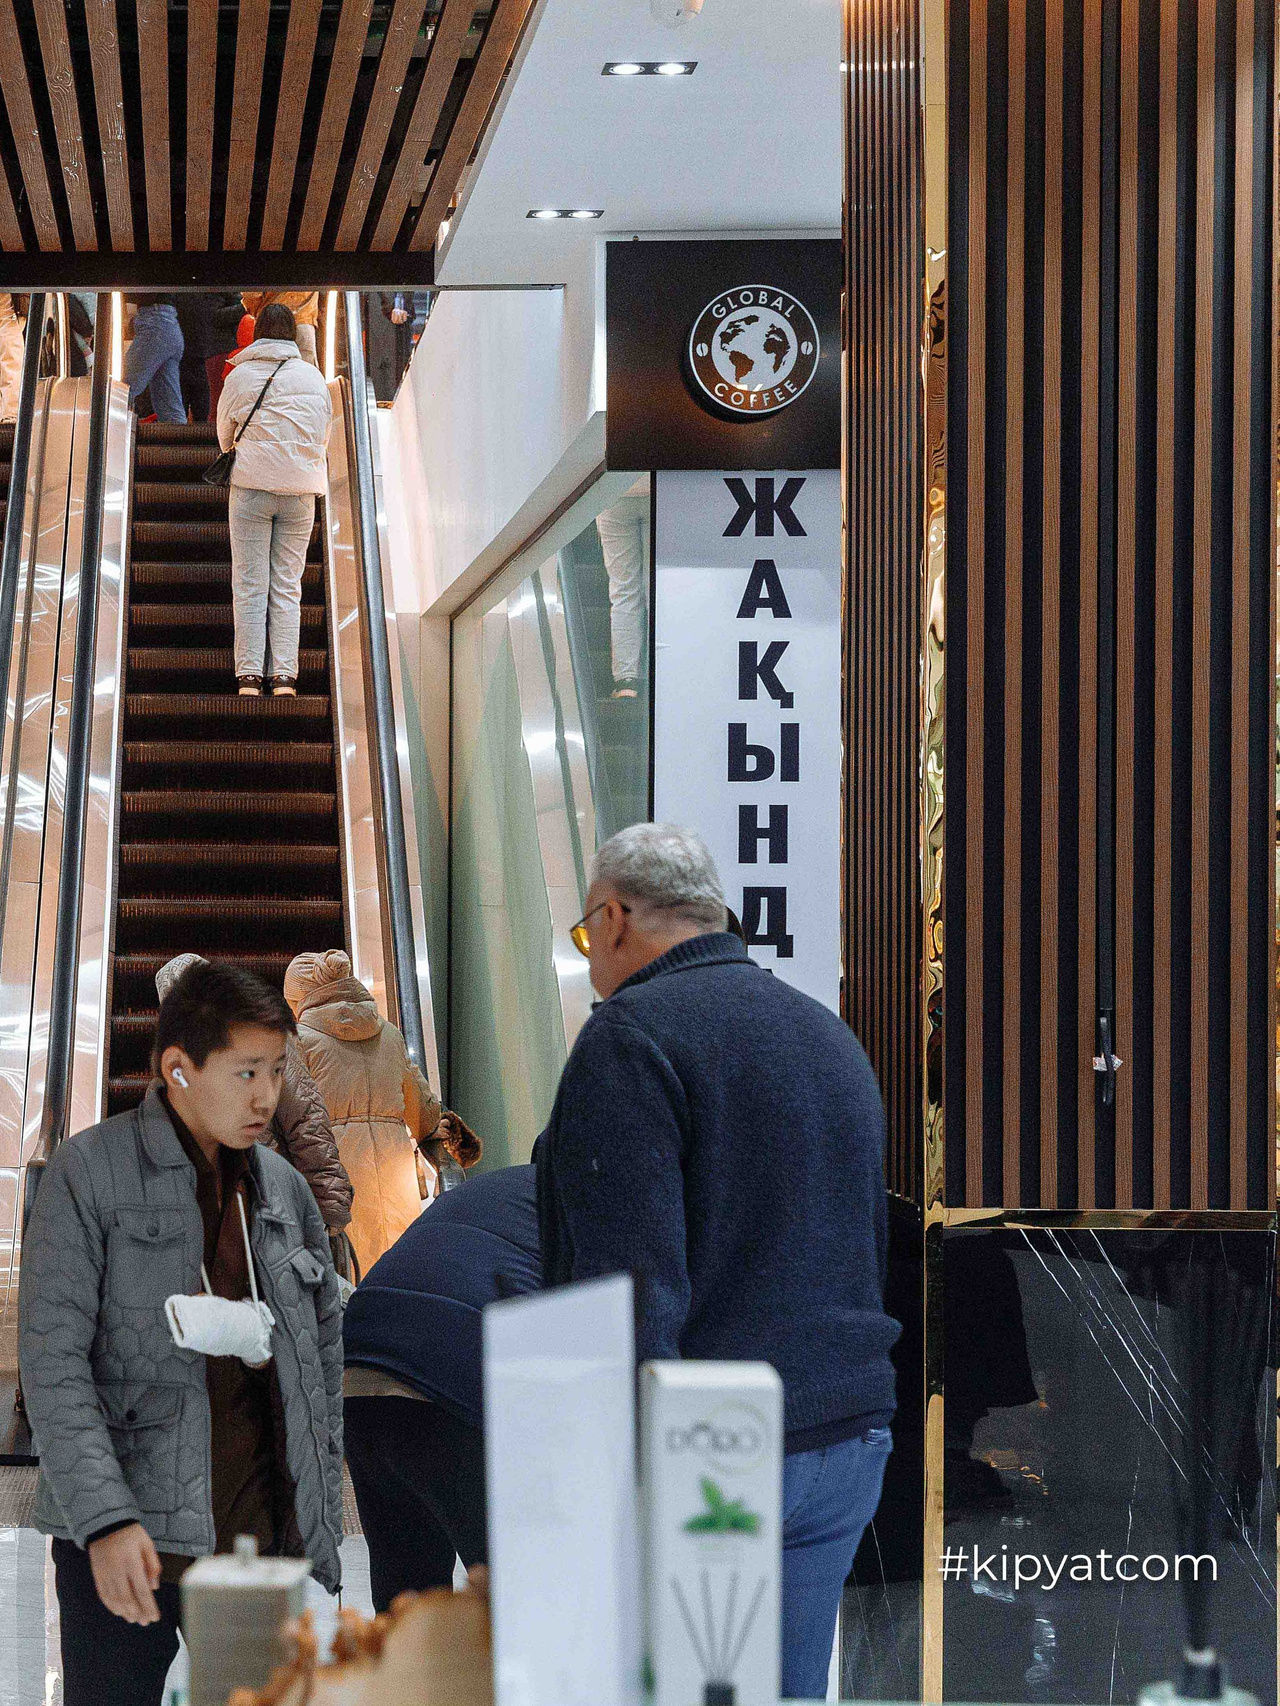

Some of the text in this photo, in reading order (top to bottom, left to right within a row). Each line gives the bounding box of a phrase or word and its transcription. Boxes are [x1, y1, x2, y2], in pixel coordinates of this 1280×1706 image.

[712, 290, 795, 318] GLOBAL
[714, 379, 798, 408] COFFEE
[721, 477, 808, 974] ЖАҚЫНД
